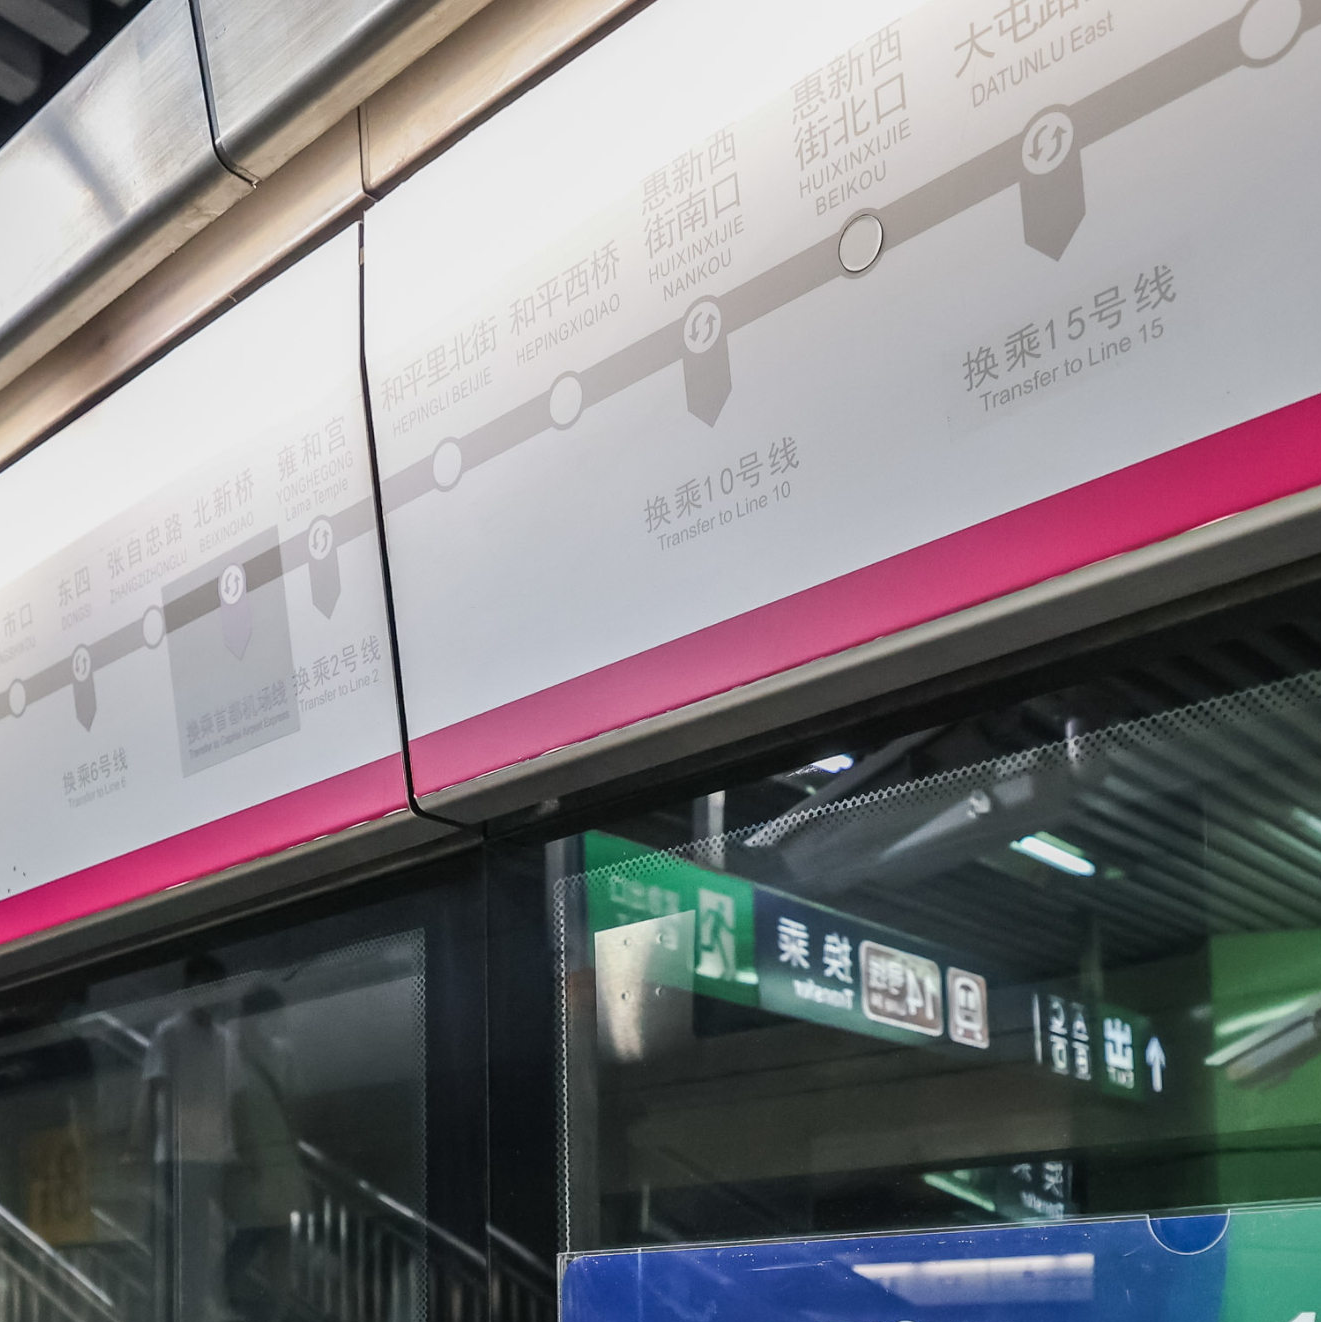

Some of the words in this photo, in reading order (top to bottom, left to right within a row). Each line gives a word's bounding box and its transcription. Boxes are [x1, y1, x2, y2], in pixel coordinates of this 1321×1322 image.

[790, 17, 903, 126] 惠新西
[972, 36, 1065, 108] DATUNLU
[1070, 9, 1114, 53] East
[793, 72, 907, 171] 街北口
[640, 121, 736, 215] 惠新西
[799, 118, 912, 199] HUIXINXIJIE
[816, 160, 887, 216] BEIKOU
[643, 172, 741, 259] 街南口
[648, 214, 745, 284] HUIXINXIJIE
[509, 240, 620, 337] 和平西桥
[663, 248, 732, 301] NANKOU
[516, 293, 621, 367] HEPINGXIQIAO
[962, 264, 1176, 391] 换乘15号线
[380, 315, 498, 413] 和平里北街
[979, 367, 1059, 412] Transfer
[1063, 353, 1082, 377] to
[1089, 333, 1132, 367] Line
[1137, 316, 1165, 346] 15
[393, 391, 450, 438] HEPINGLI
[452, 366, 493, 404] BEIJIE
[276, 451, 354, 506] YONGHEGONG
[277, 415, 346, 482] 雍和宫
[193, 467, 255, 530] 北新桥
[284, 497, 311, 522] Lama
[311, 478, 349, 507] Temple
[644, 436, 800, 533] 换乘10号线
[657, 515, 716, 552] Transfer
[719, 506, 733, 526] to
[736, 490, 768, 519] Line
[771, 480, 792, 501] 10
[106, 512, 182, 579] 张自忠路
[198, 511, 255, 553] BEIXINQIAO
[57, 566, 91, 607] 东四
[109, 549, 187, 604] ZHANGZIZHONGLU
[60, 603, 93, 631] DONGSI
[292, 635, 382, 697] 换乘2号线
[298, 688, 337, 713] Transfer
[338, 684, 348, 697] to
[349, 674, 371, 693] Line
[372, 668, 379, 683] 2
[62, 748, 128, 796] 换乘6号线
